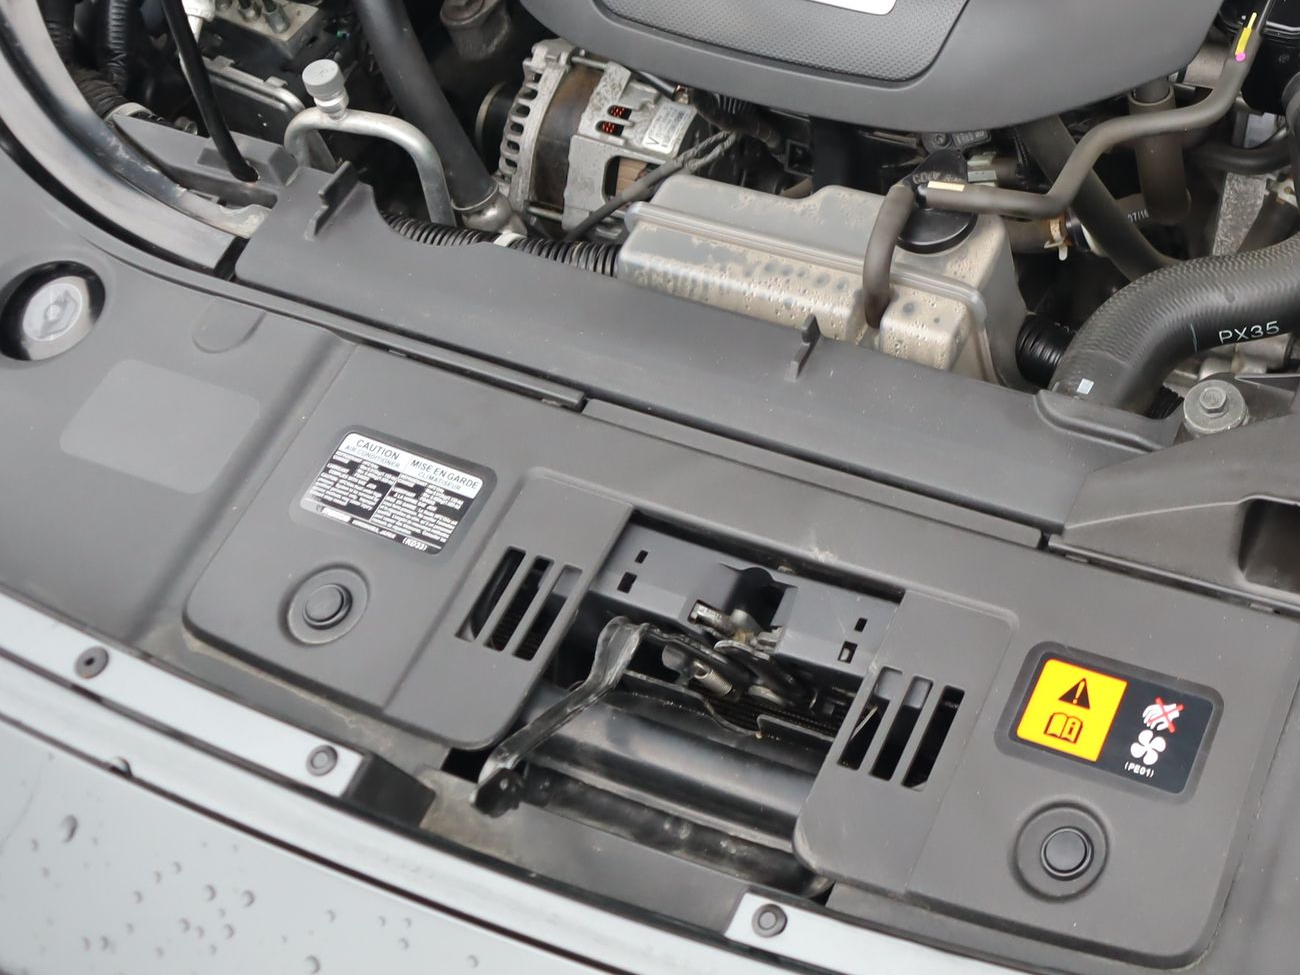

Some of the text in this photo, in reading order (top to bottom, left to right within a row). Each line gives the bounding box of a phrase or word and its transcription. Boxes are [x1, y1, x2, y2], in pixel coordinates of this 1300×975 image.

[1218, 320, 1280, 344] PX35
[356, 439, 400, 461] CAUTION
[357, 448, 400, 468] CONDITIONER
[410, 459, 479, 489] MISE EN GARDE
[417, 471, 462, 491] CLIMATISEUR
[402, 536, 428, 552] (KD33)
[1124, 760, 1155, 778] (PE01)
